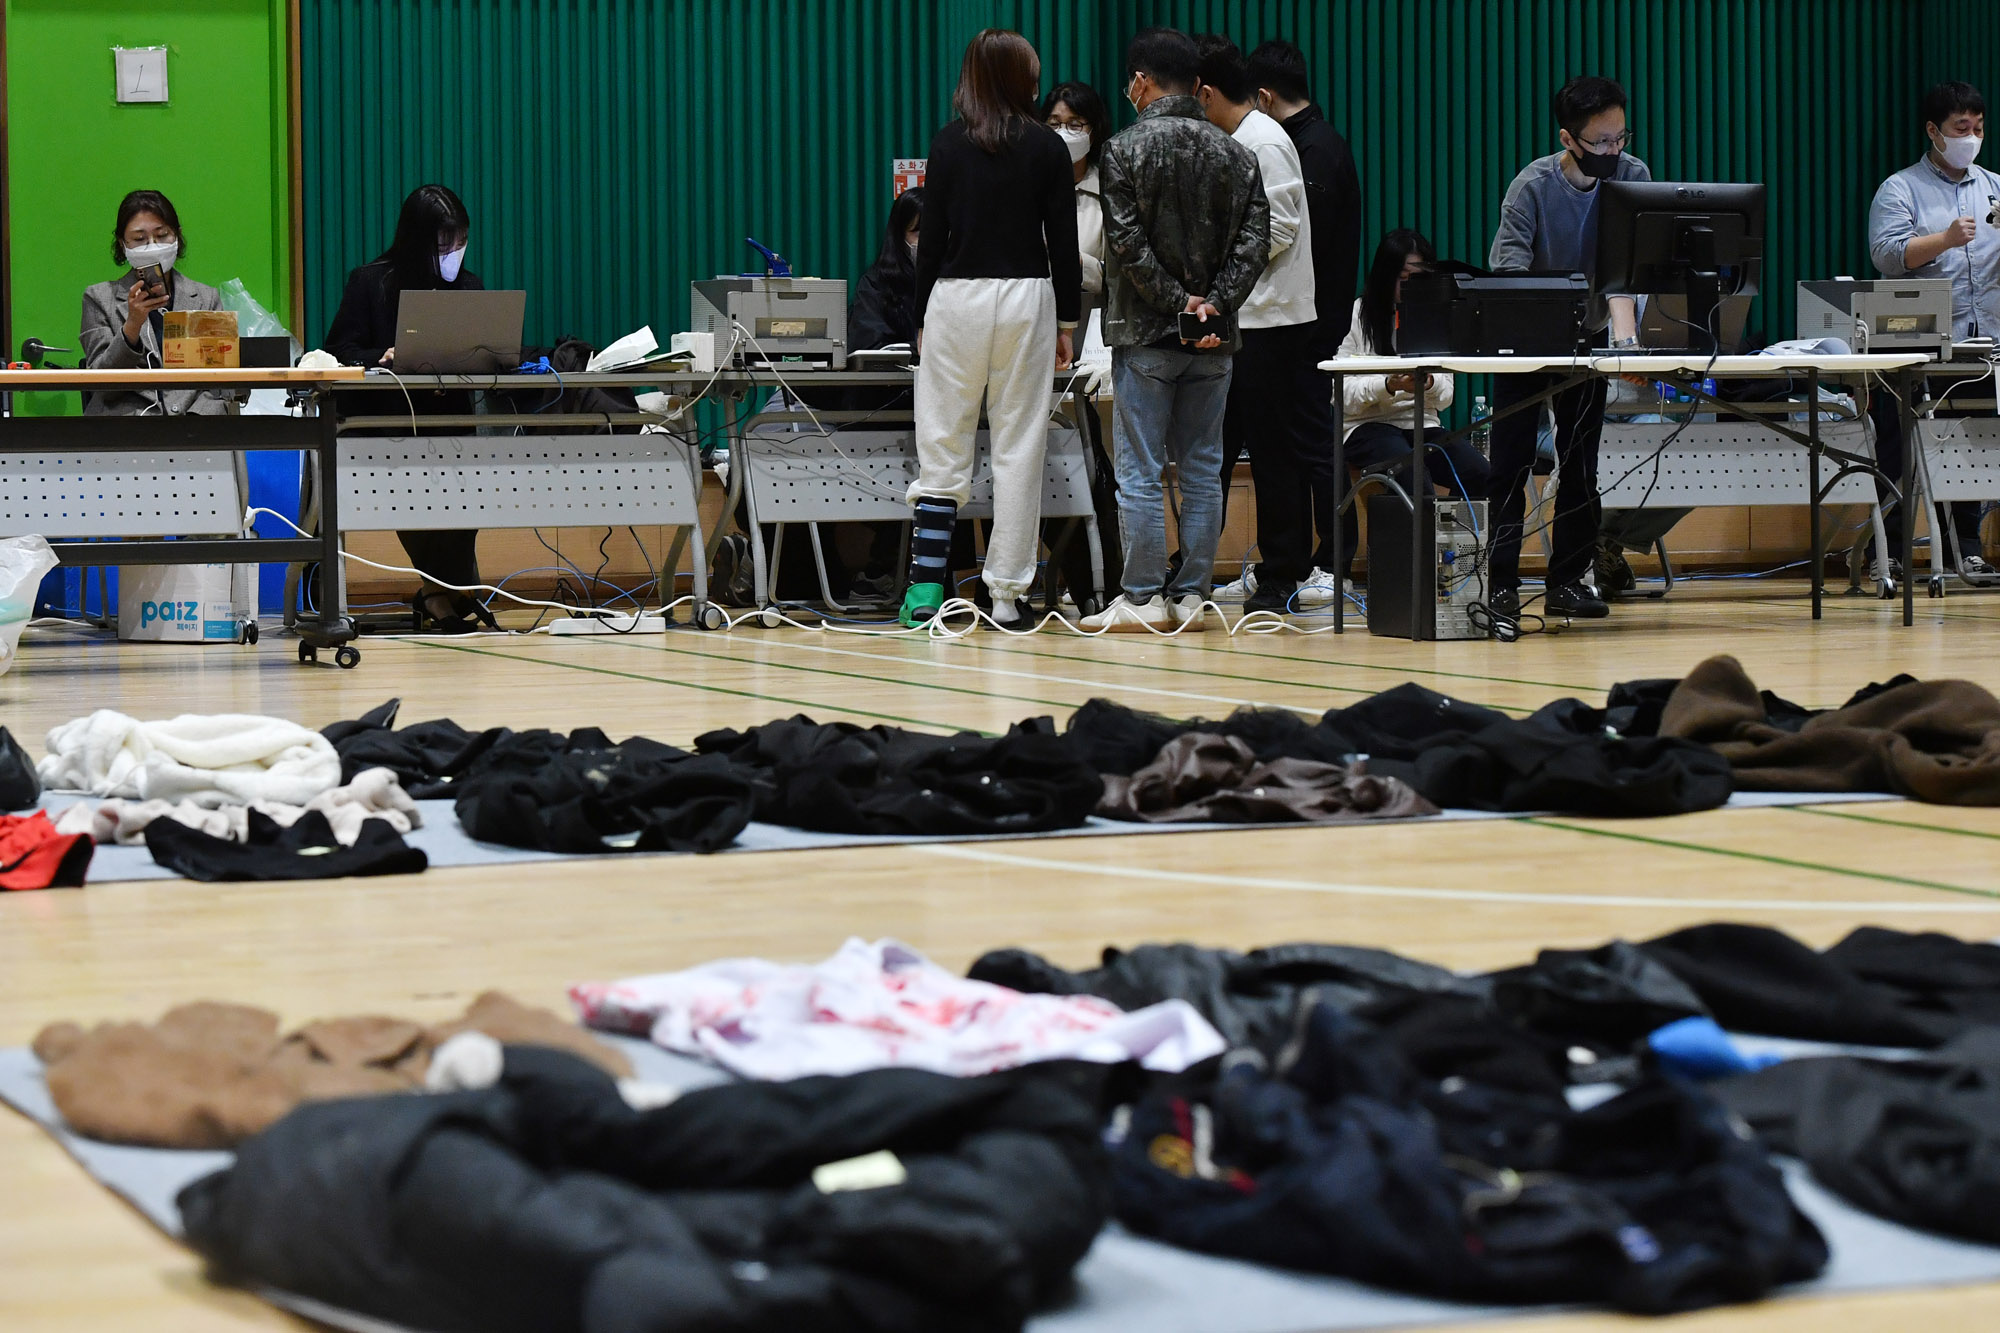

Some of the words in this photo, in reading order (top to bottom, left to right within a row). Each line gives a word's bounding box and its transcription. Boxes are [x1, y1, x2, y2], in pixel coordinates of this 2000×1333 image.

[129, 64, 151, 94] 1
[1691, 190, 1705, 199] LG
[141, 601, 198, 629] paiz
[176, 623, 198, 631] 페이지
